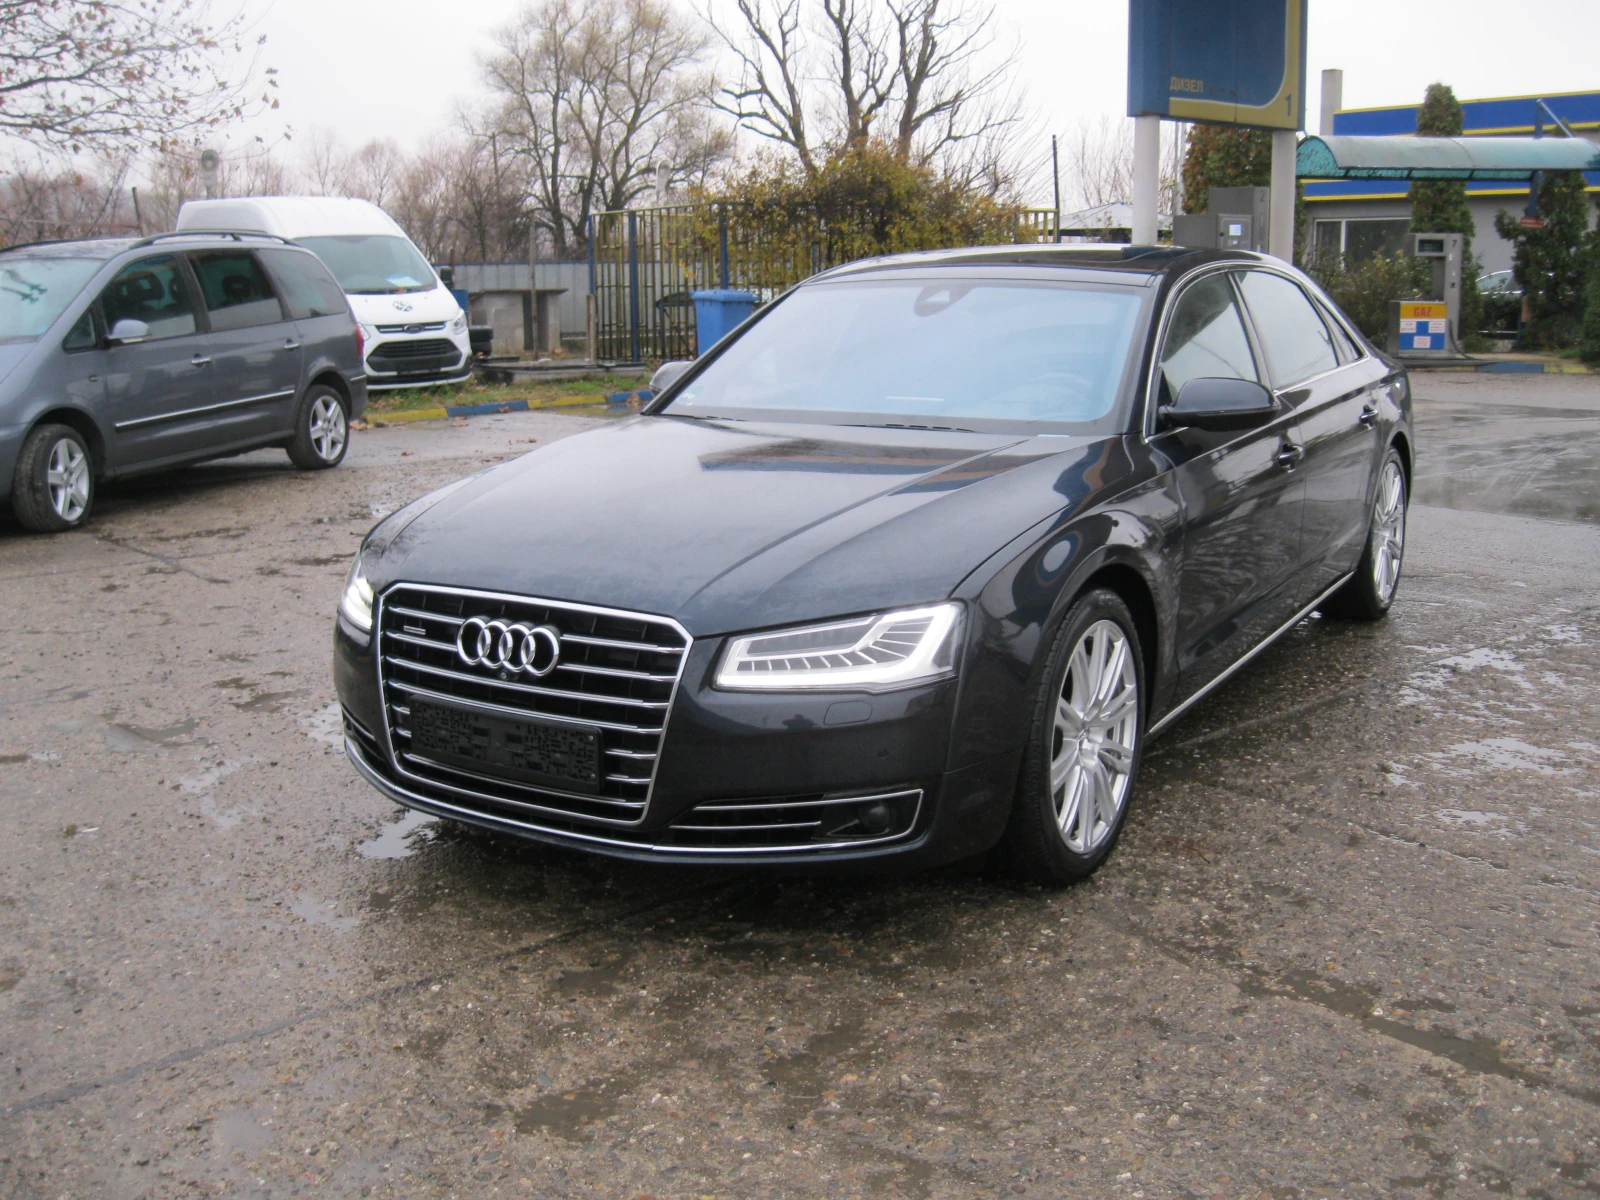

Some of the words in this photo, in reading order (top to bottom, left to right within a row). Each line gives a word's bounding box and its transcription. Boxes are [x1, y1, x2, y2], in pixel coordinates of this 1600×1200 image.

[1170, 76, 1203, 93] ДИЗЕЛ
[1284, 94, 1292, 117] 1
[1259, 189, 1266, 203] 2
[1452, 239, 1457, 248] 7
[1413, 306, 1432, 318] GAZ
